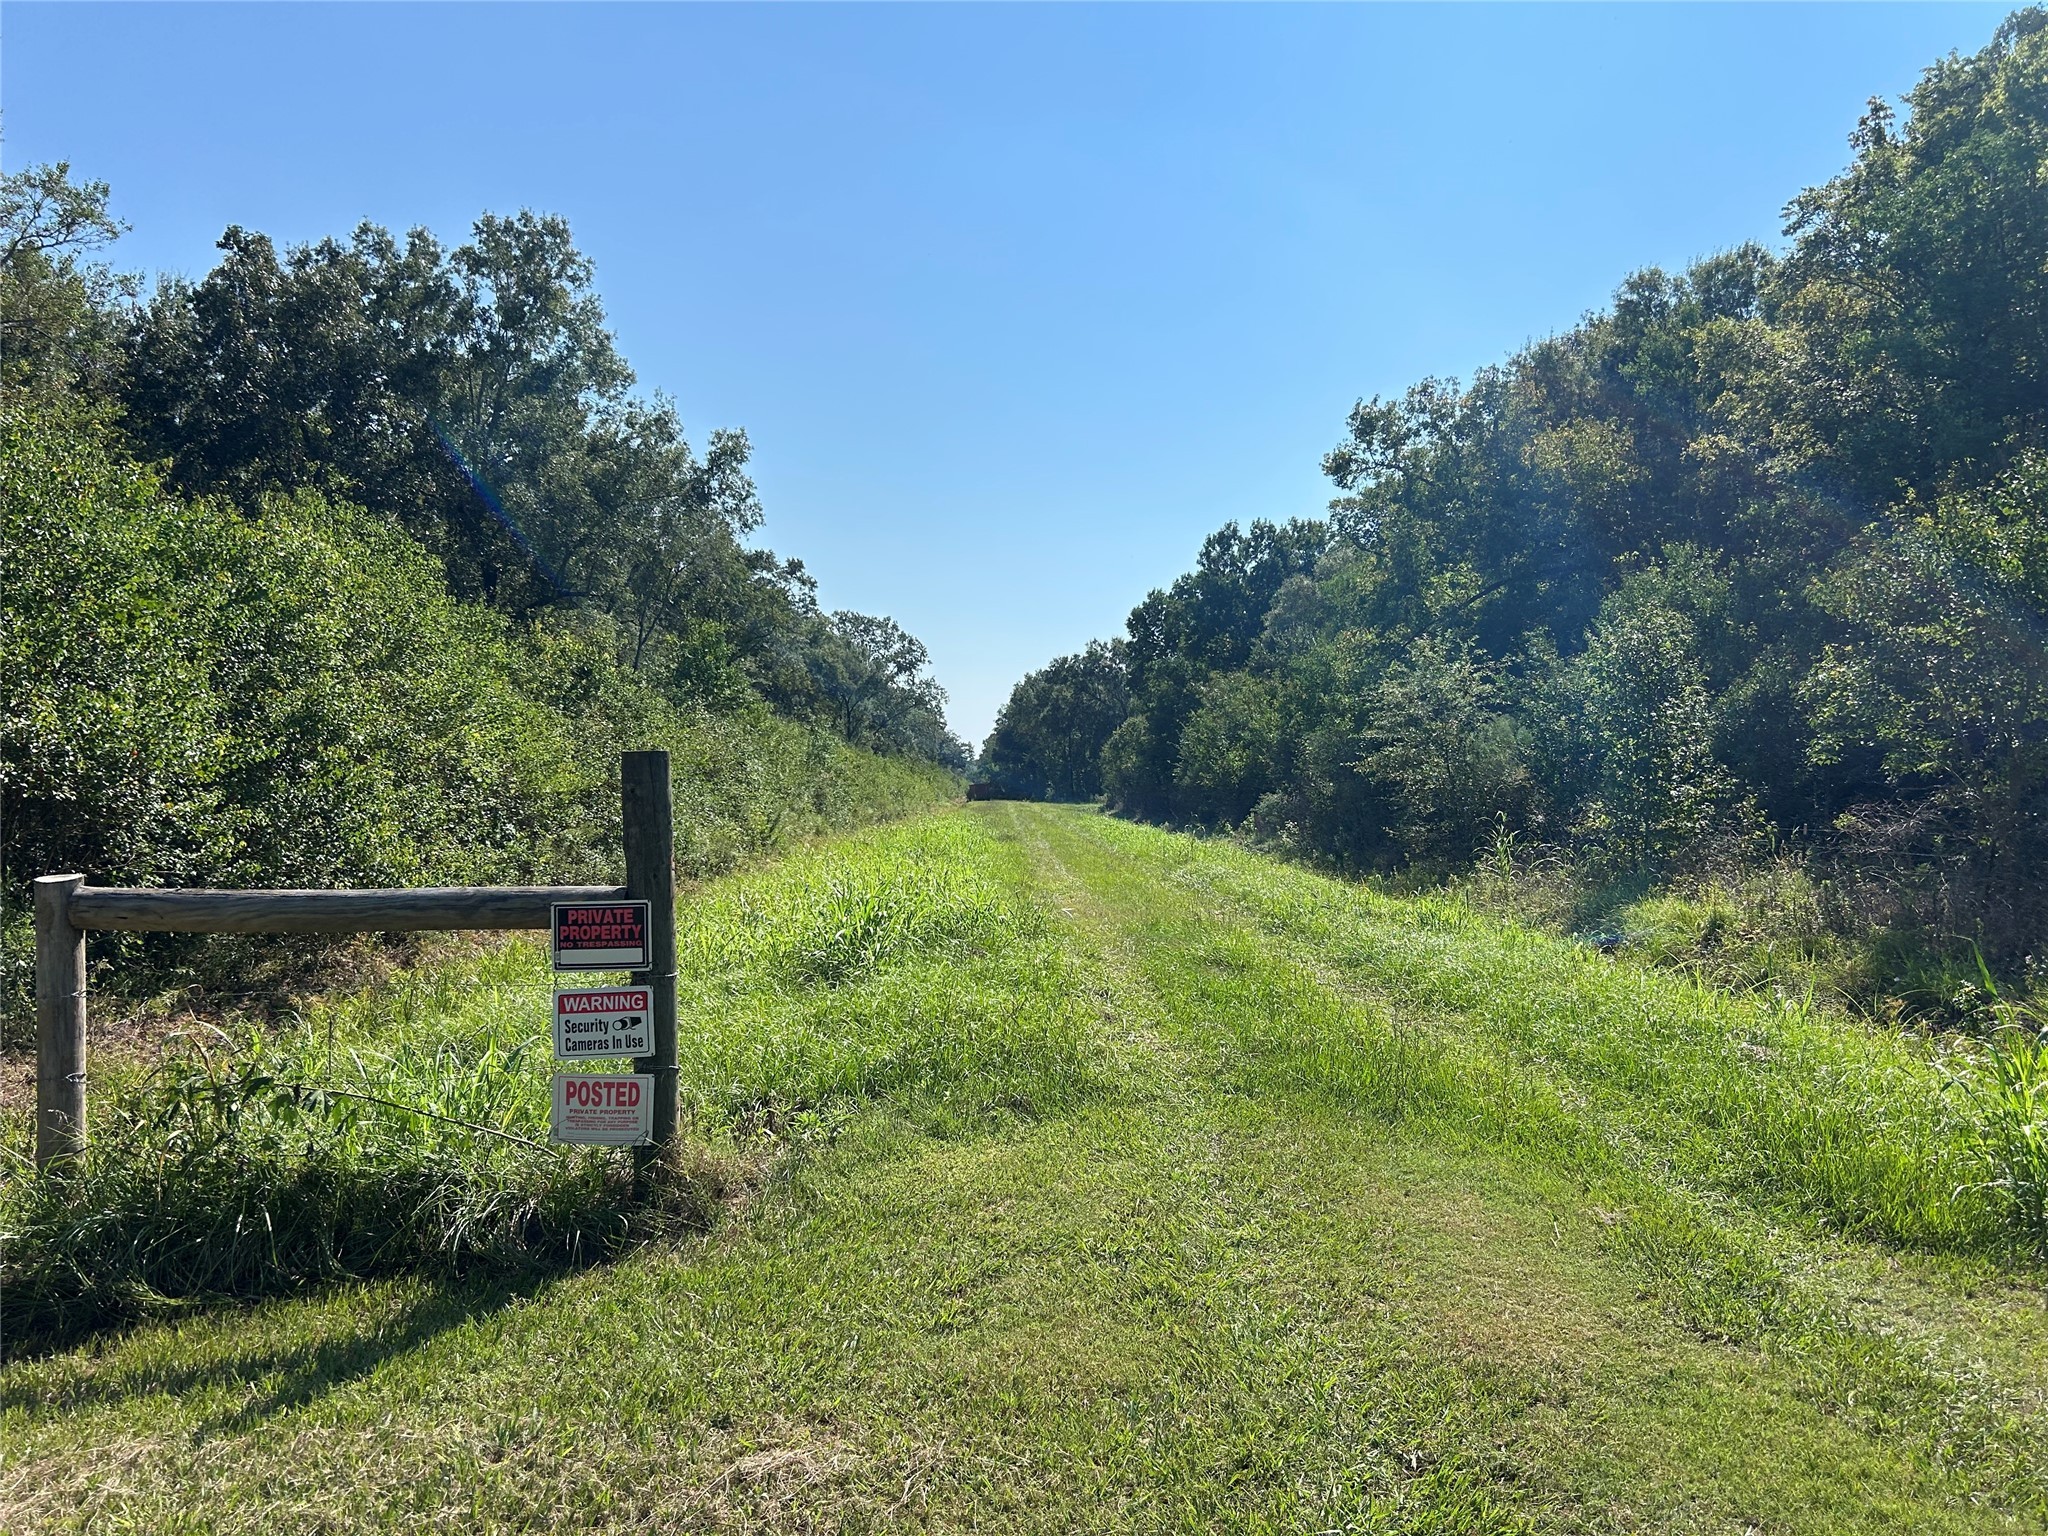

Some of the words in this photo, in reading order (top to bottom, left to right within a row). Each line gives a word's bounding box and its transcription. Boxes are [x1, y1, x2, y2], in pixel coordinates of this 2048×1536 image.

[567, 908, 634, 924] PRIVATE
[560, 924, 642, 940] PROPERTY
[577, 940, 643, 948] TRESPASSING
[563, 994, 644, 1012] WARNING
[564, 1018, 609, 1035] Security
[565, 1038, 609, 1052] Cameras
[612, 1035, 622, 1049] In
[625, 1034, 644, 1049] Use
[565, 1080, 641, 1107] POSTED
